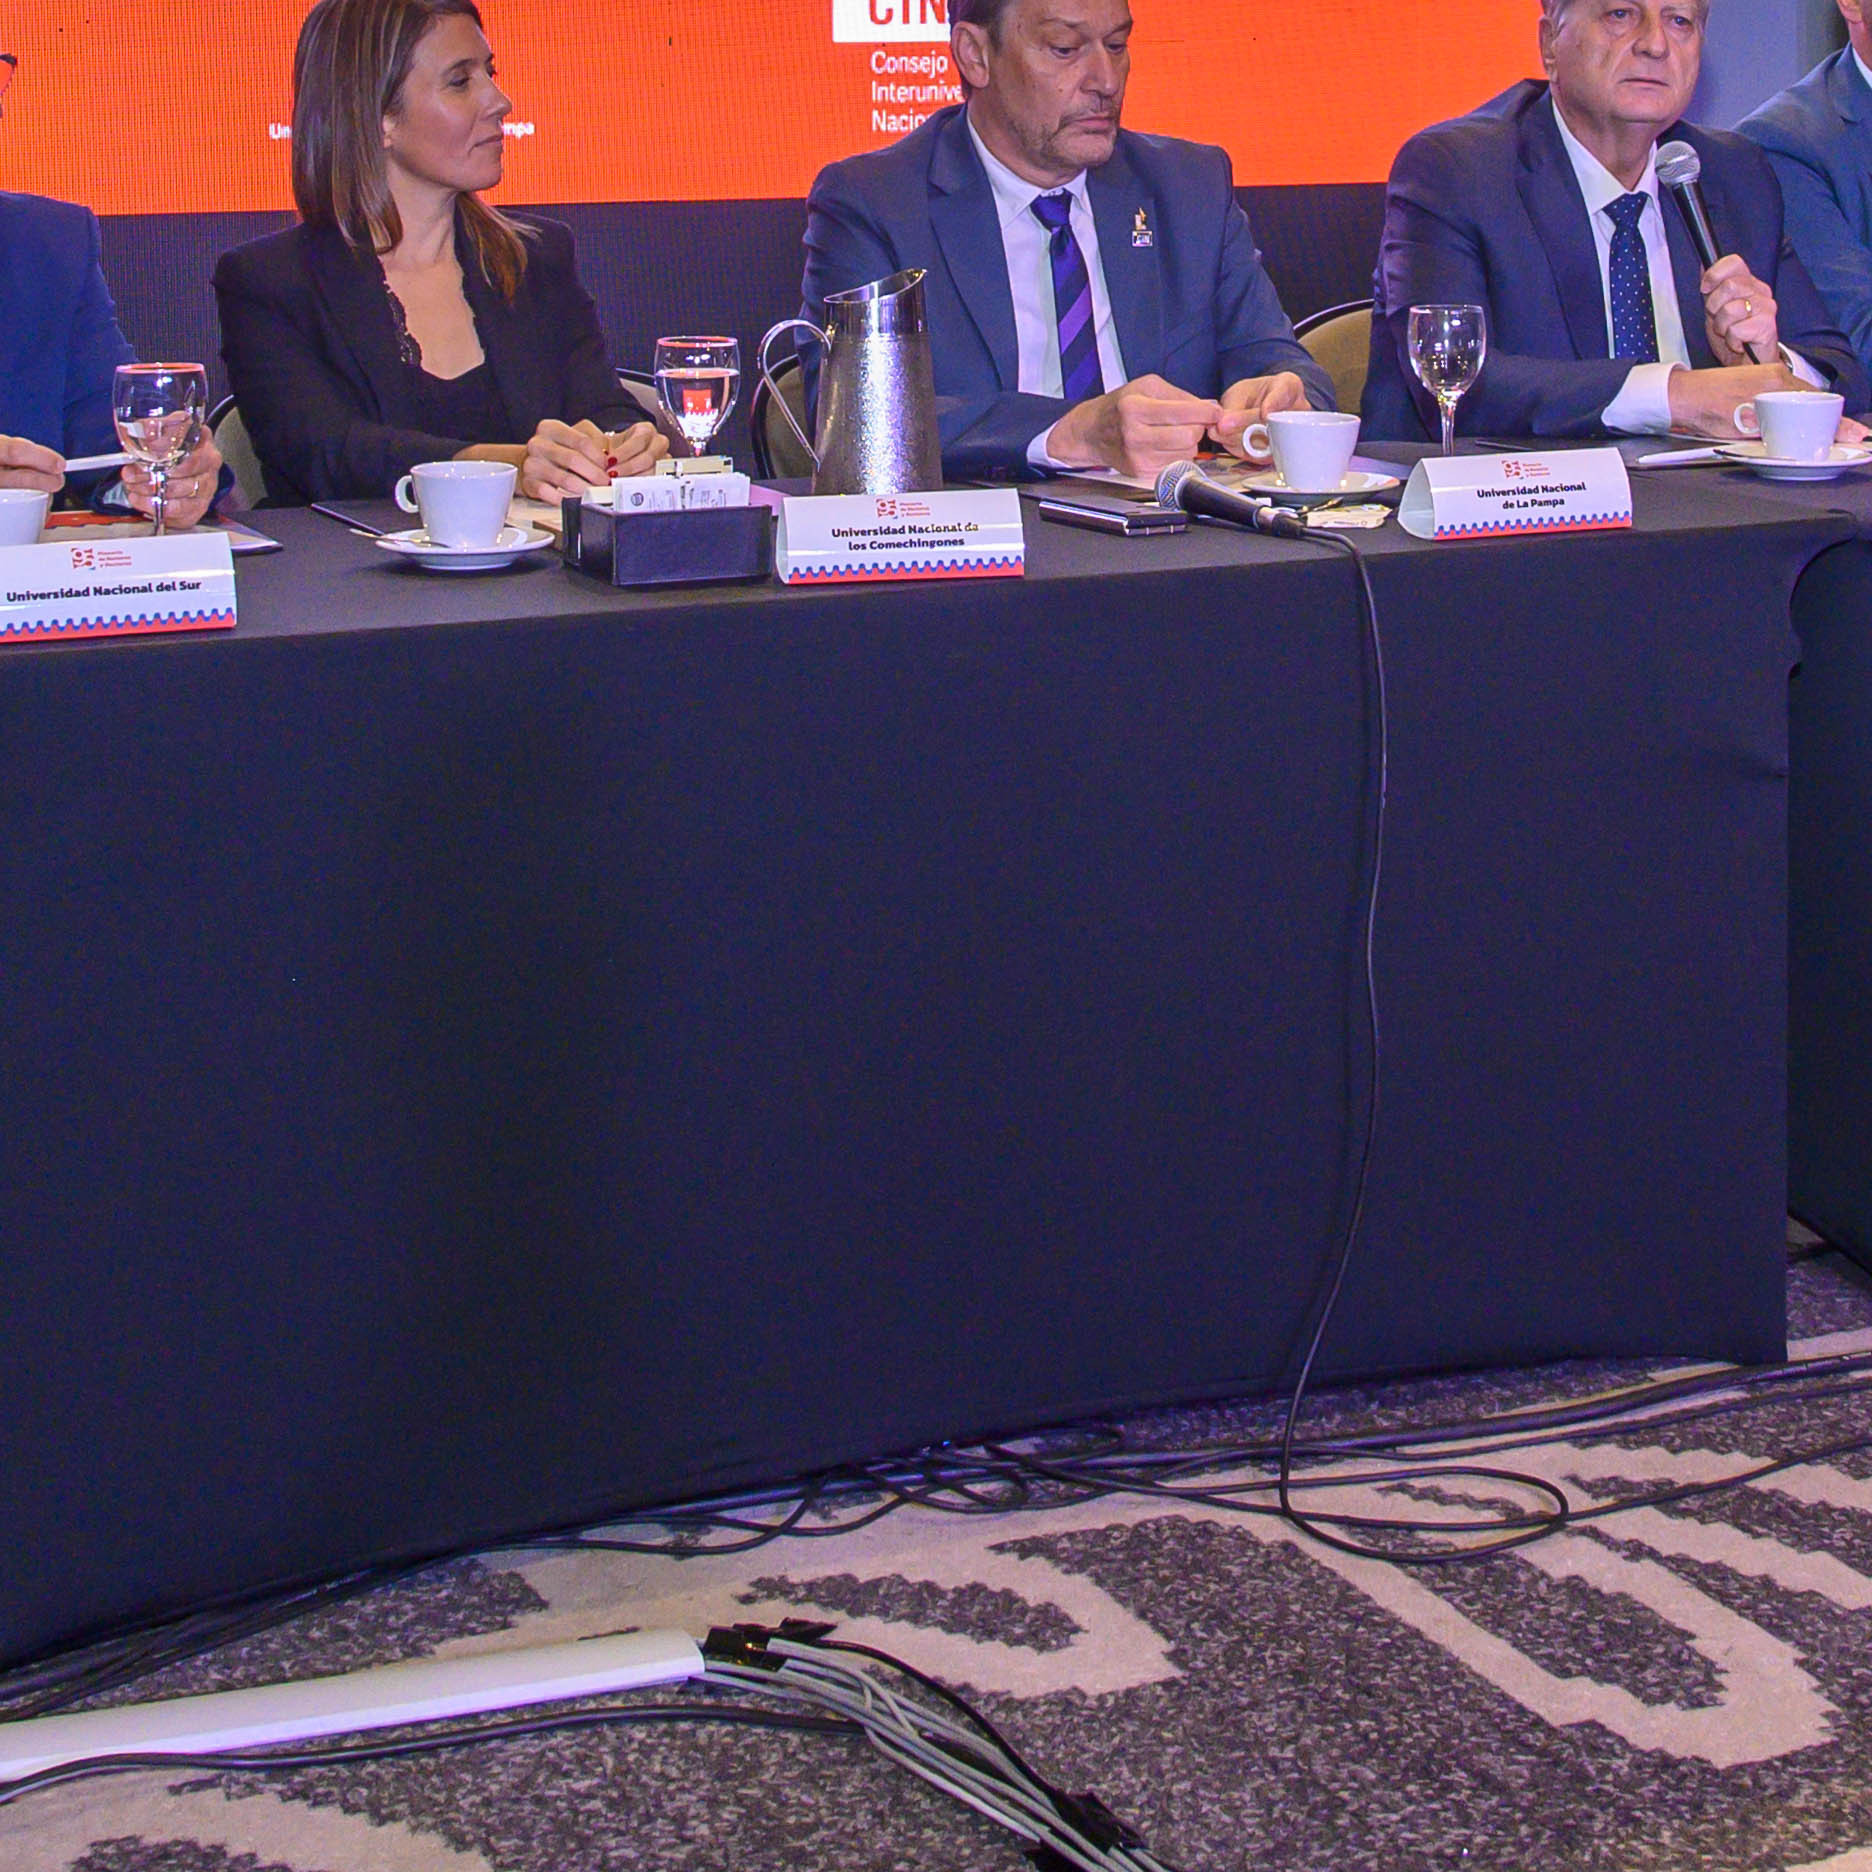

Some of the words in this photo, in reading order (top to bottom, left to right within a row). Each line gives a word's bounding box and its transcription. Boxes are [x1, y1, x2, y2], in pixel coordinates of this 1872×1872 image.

[870, 50, 948, 79] Consejo
[871, 79, 965, 103] Interunive
[1476, 485, 1540, 499] Universidad
[1540, 481, 1587, 494] Nacional
[1502, 500, 1515, 509] de
[1516, 499, 1529, 508] La
[1530, 497, 1565, 509] Pampa
[831, 524, 906, 538] Universidad
[908, 522, 963, 535] Nacional
[848, 541, 867, 551] los
[869, 537, 965, 551] Comechingones
[6, 586, 90, 603] Universidad
[93, 582, 153, 597] Nacional
[155, 580, 177, 593] del
[179, 580, 203, 591] Sur
